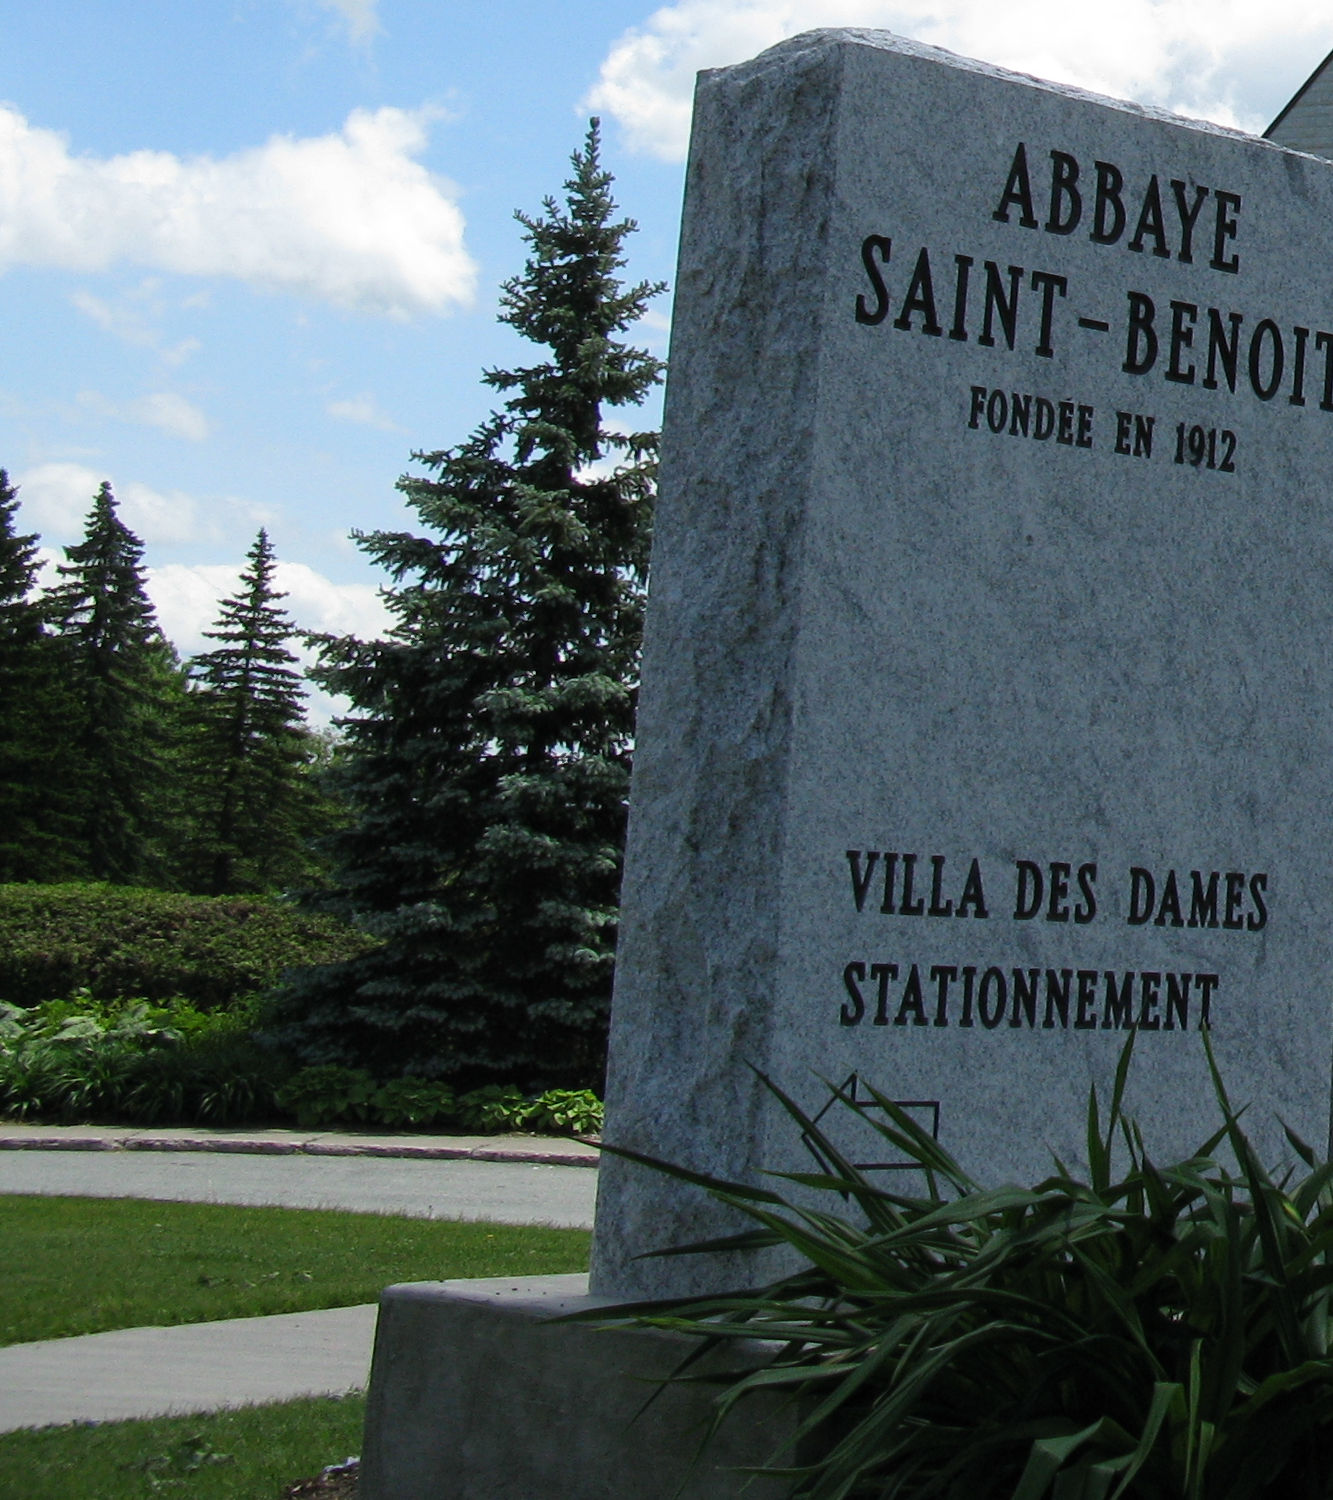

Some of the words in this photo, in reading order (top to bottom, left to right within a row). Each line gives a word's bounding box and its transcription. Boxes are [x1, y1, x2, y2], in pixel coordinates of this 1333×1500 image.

[992, 141, 1242, 275] ABBAYE
[967, 385, 1094, 449] FONDÉE
[1114, 410, 1156, 460] EN
[1173, 422, 1237, 474] 1912
[845, 849, 990, 919] VILLA
[1012, 859, 1098, 925] DES
[1126, 866, 1268, 932] DAMES
[839, 961, 1220, 1031] STATIONNEMENT
